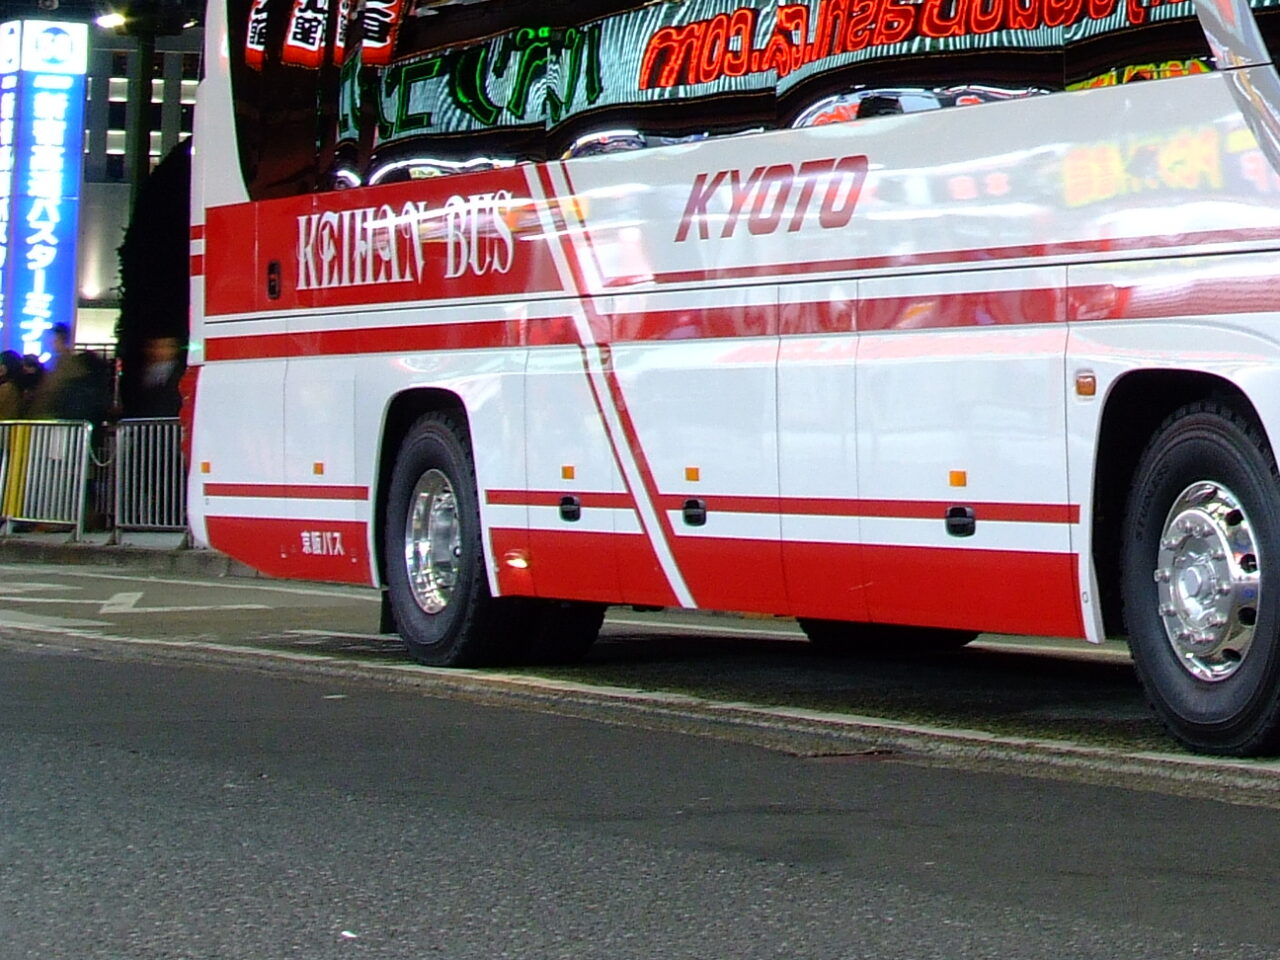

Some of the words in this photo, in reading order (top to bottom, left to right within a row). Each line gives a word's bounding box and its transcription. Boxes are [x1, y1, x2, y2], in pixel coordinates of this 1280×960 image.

[295, 199, 427, 292] KEIHAN
[444, 189, 517, 281] BUS
[674, 153, 868, 243] KYOTO
[300, 530, 345, 556] 京阪バス
